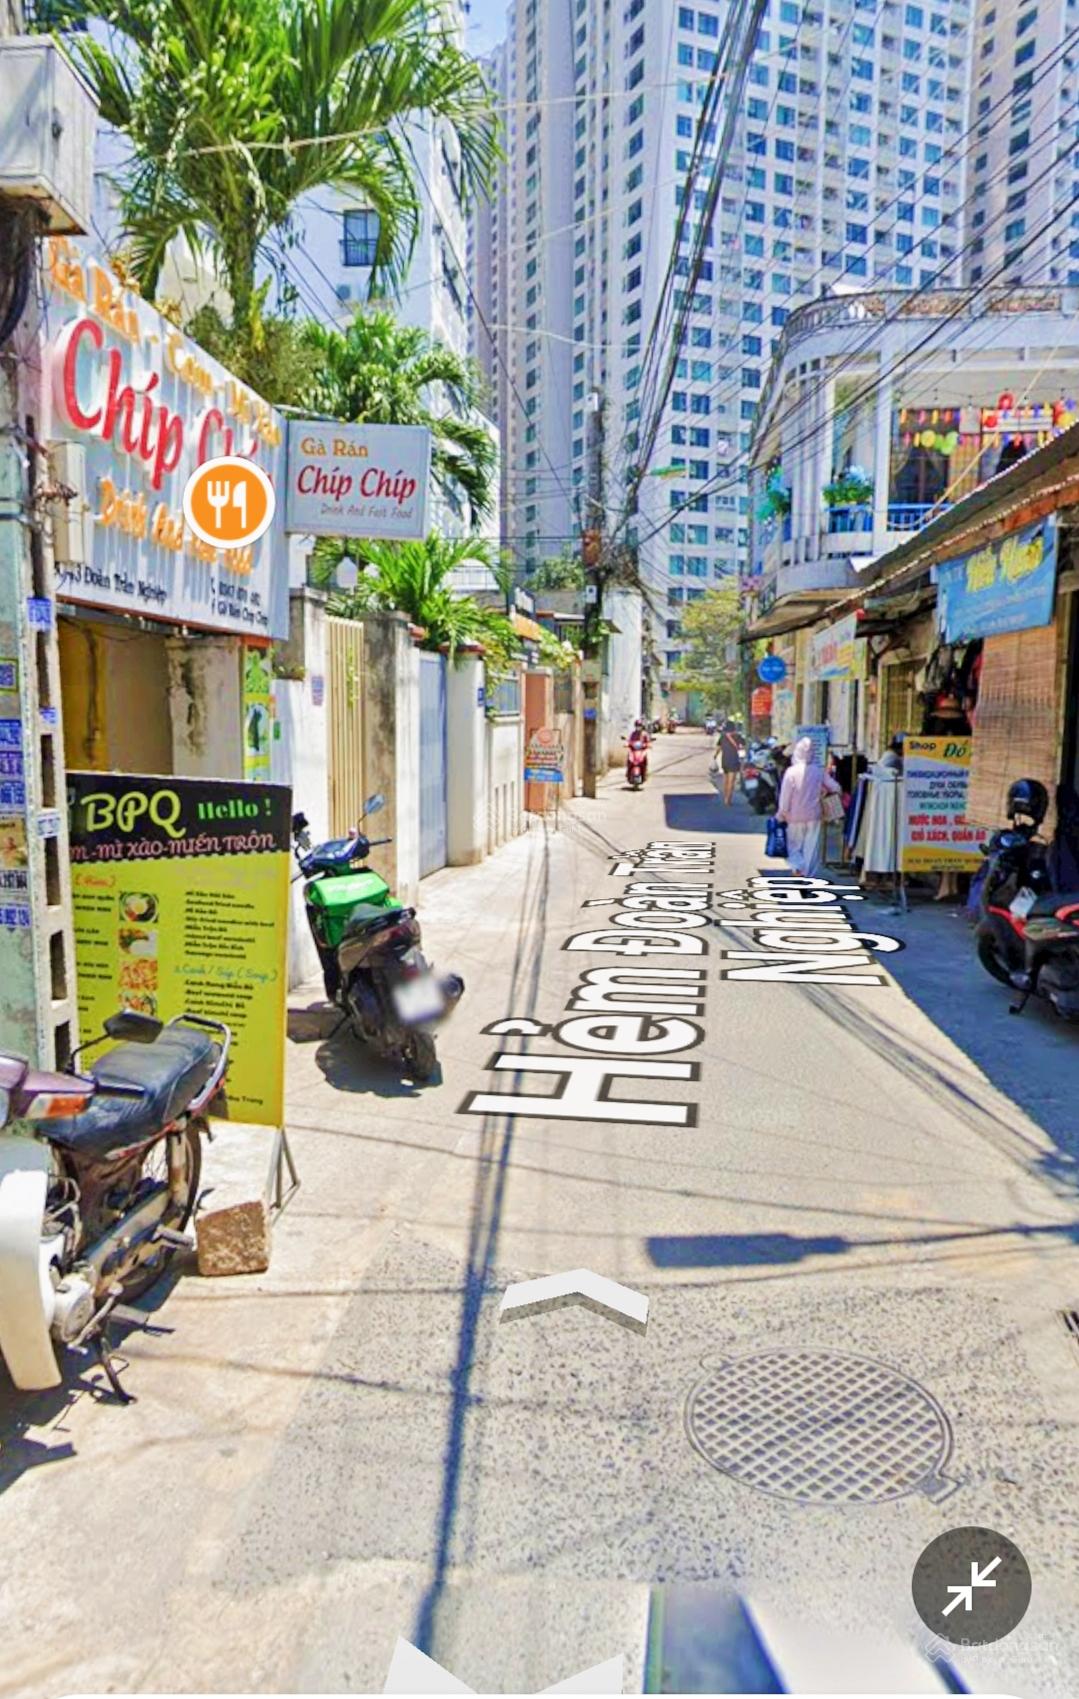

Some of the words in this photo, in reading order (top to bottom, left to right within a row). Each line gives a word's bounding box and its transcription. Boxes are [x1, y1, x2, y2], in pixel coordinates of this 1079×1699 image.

[62, 317, 184, 491] Chíp
[301, 437, 326, 457] Gà
[333, 439, 369, 458] Rán
[297, 464, 352, 501] Chíp
[360, 467, 417, 504] Chíp
[391, 507, 414, 519] Food
[909, 741, 936, 751] Shop
[80, 789, 187, 839] BPQ
[198, 799, 259, 820] Hello
